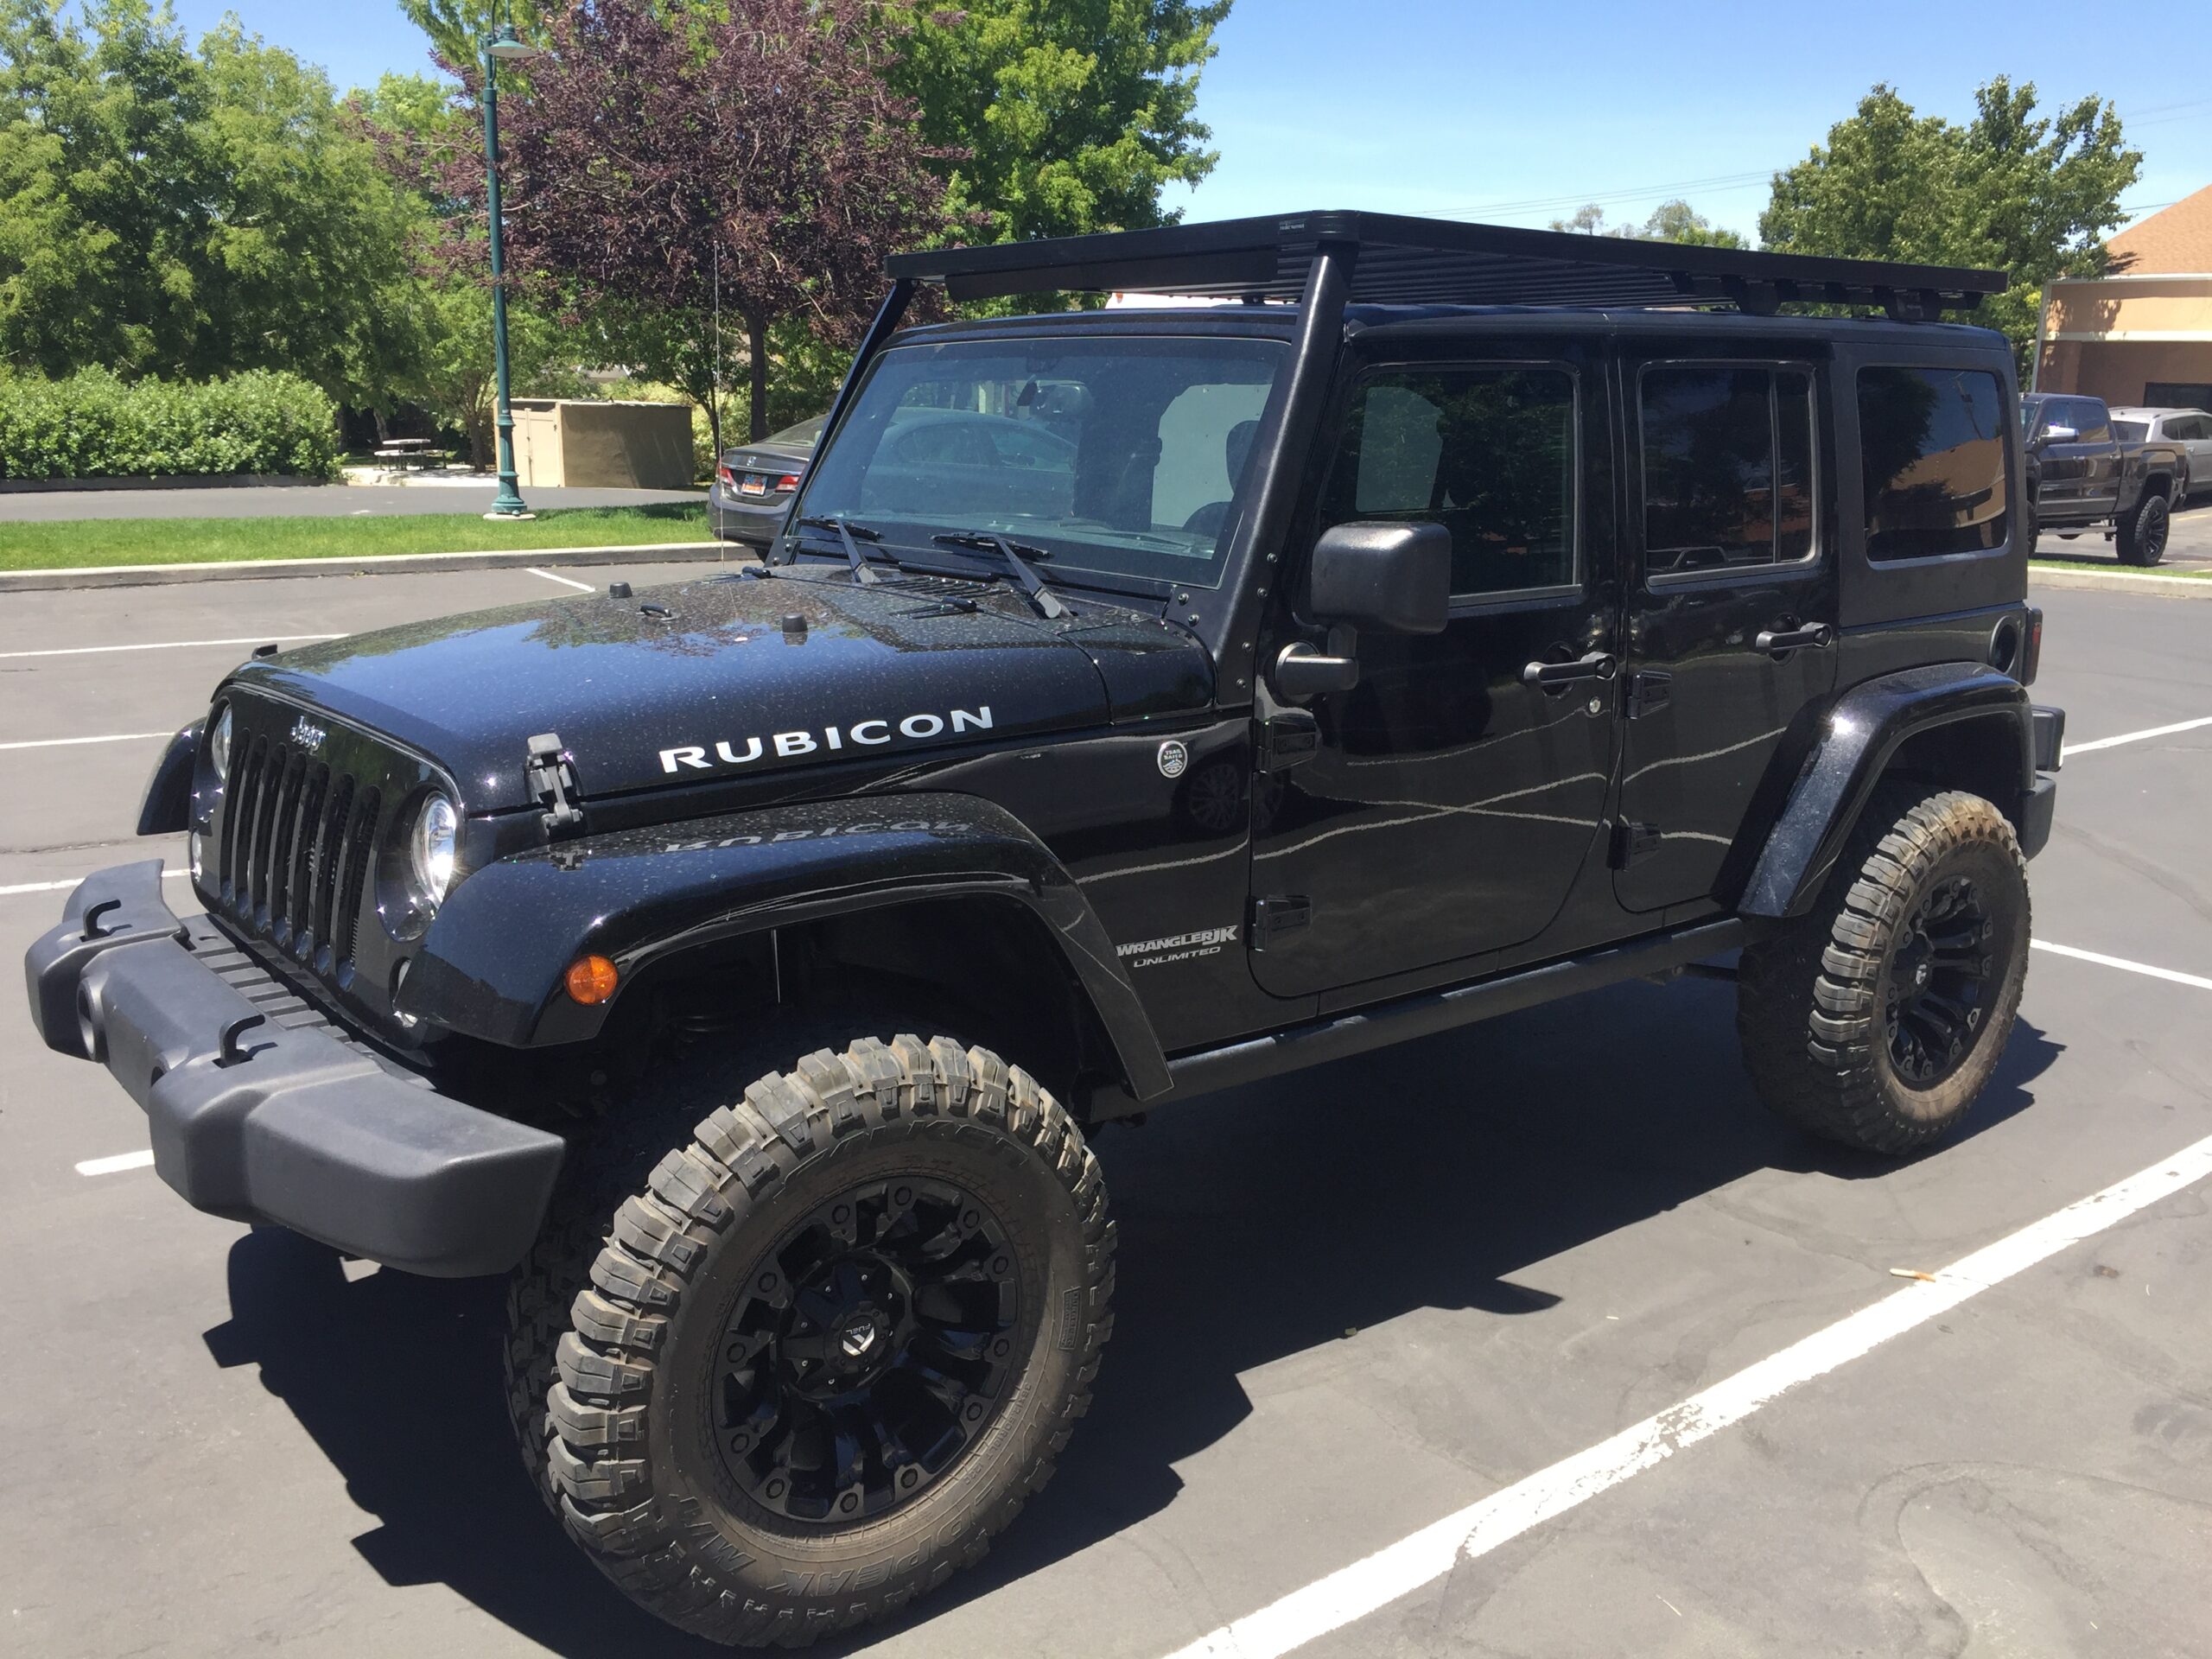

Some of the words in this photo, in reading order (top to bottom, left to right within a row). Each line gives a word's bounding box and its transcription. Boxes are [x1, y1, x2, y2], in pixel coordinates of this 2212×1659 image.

[290, 715, 326, 756] Jeep
[659, 706, 994, 772] RUBICON
[1134, 946, 1221, 968] UNLIMITED
